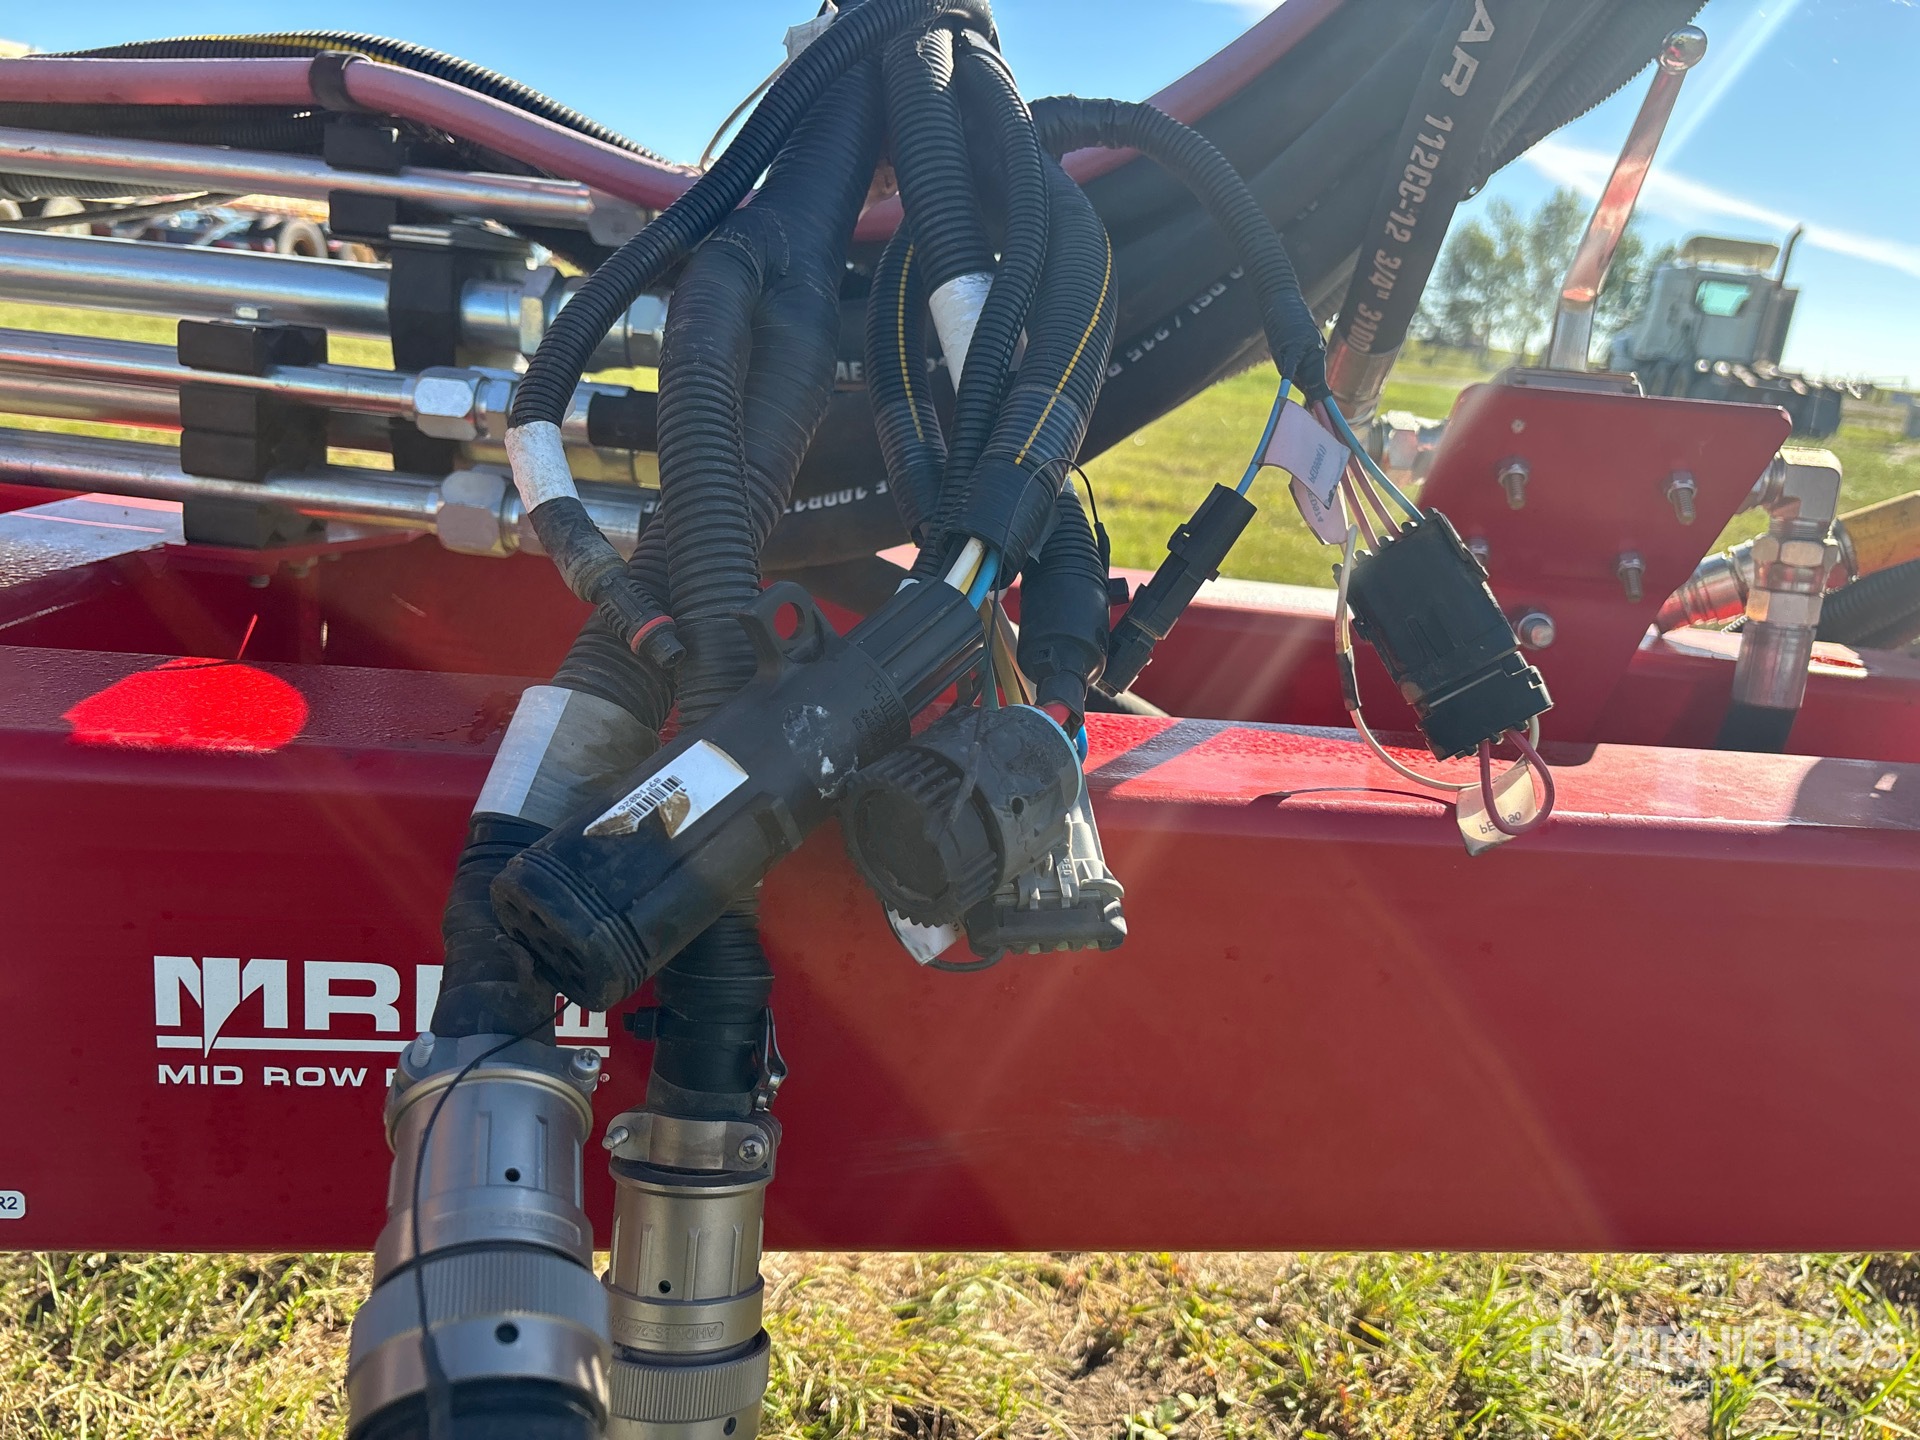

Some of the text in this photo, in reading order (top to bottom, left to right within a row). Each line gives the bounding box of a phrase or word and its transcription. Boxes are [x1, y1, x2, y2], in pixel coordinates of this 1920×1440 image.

[1384, 114, 1454, 243] 112CC-12
[158, 1064, 244, 1086] MID
[264, 1066, 369, 1087] ROW
